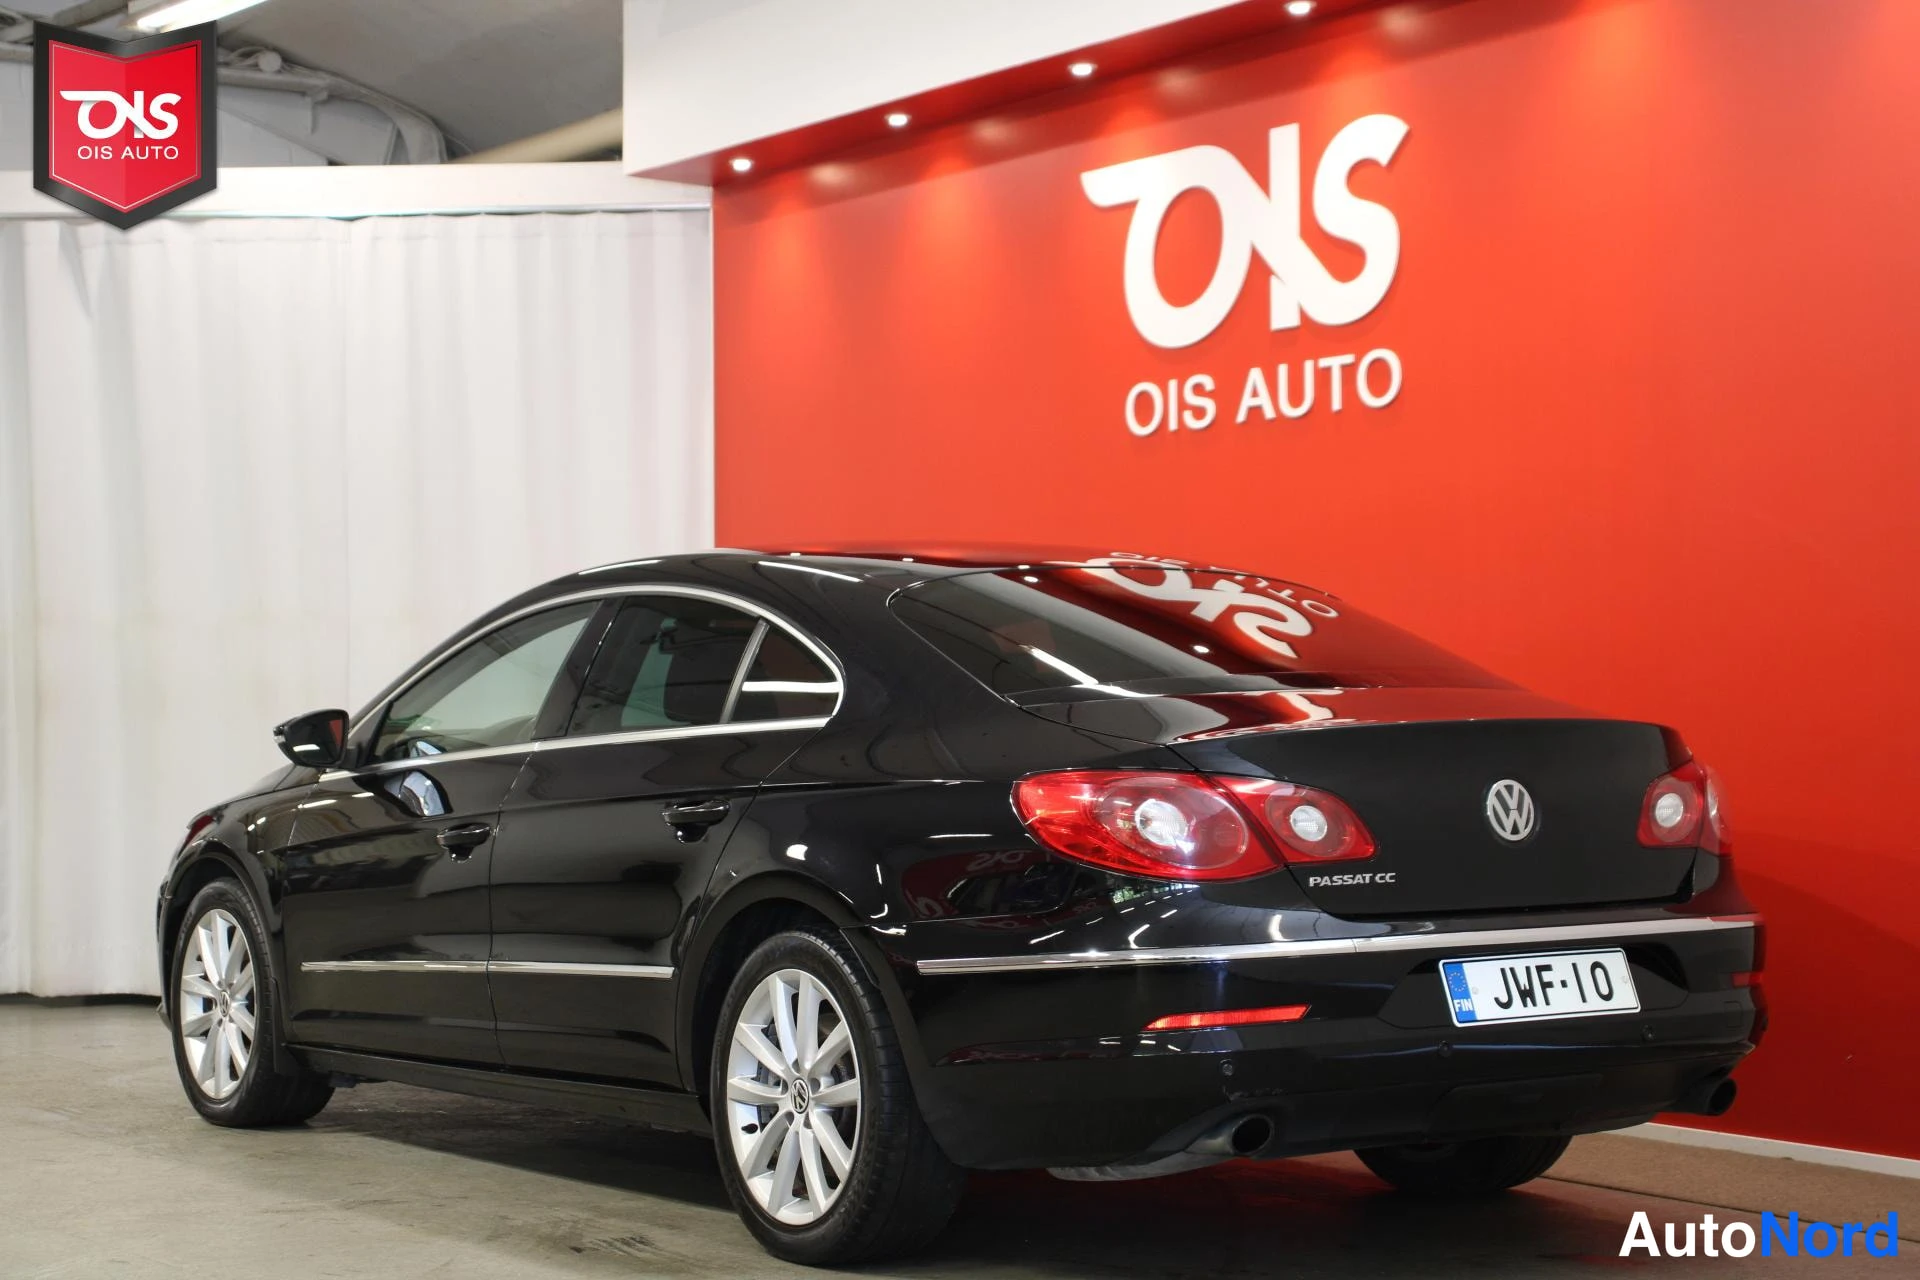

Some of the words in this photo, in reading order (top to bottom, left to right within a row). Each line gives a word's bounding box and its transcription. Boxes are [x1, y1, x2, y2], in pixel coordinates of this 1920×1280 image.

[1080, 113, 1410, 349] OIS
[1125, 373, 1217, 437] OIS
[1235, 348, 1403, 424] AUTO
[1488, 779, 1535, 841] VW
[1308, 873, 1374, 887] PASSAT
[1375, 872, 1396, 883] CC
[1454, 998, 1475, 1013] FIN
